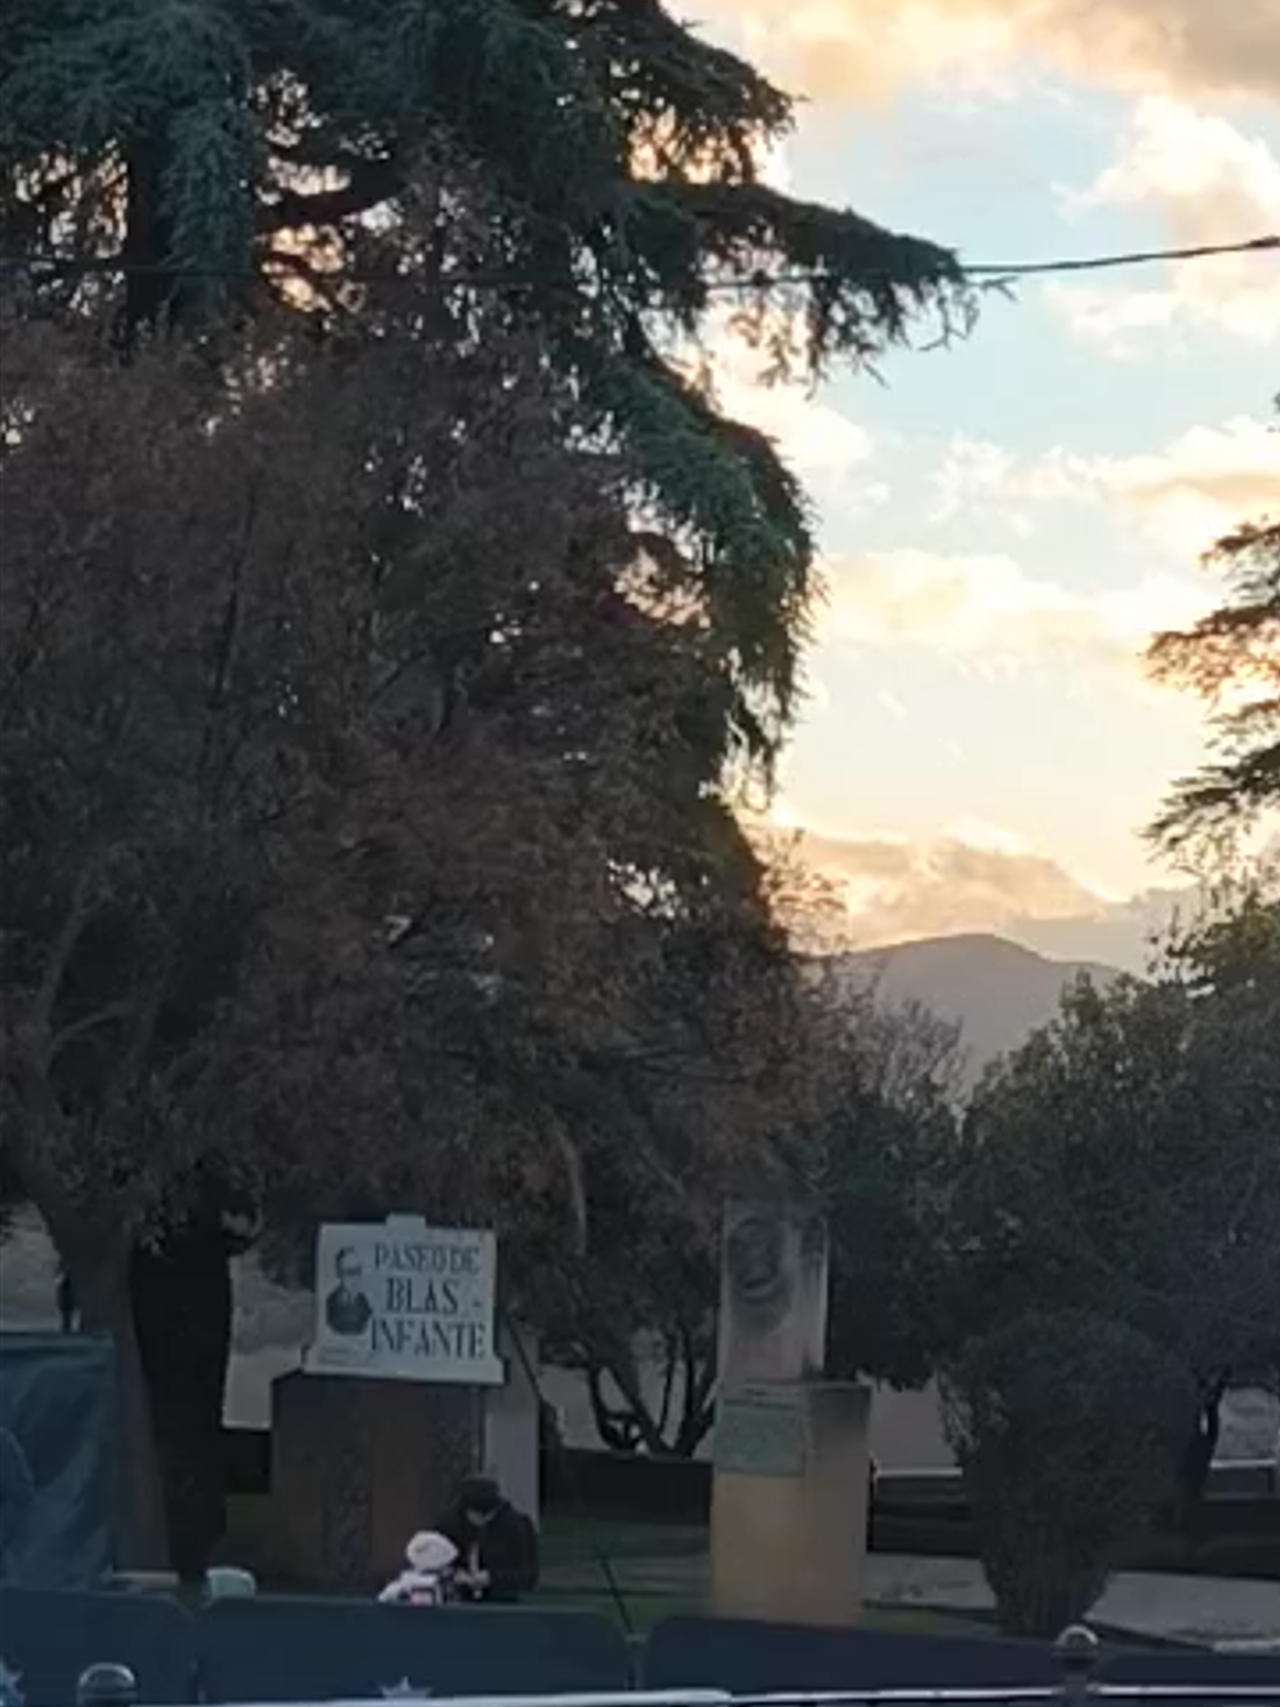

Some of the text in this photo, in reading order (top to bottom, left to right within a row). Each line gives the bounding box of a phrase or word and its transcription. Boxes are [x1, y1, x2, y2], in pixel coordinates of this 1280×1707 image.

[374, 1242, 481, 1275] PASEO DE
[385, 1277, 459, 1314] BLAS
[371, 1317, 487, 1359] INFANTE
